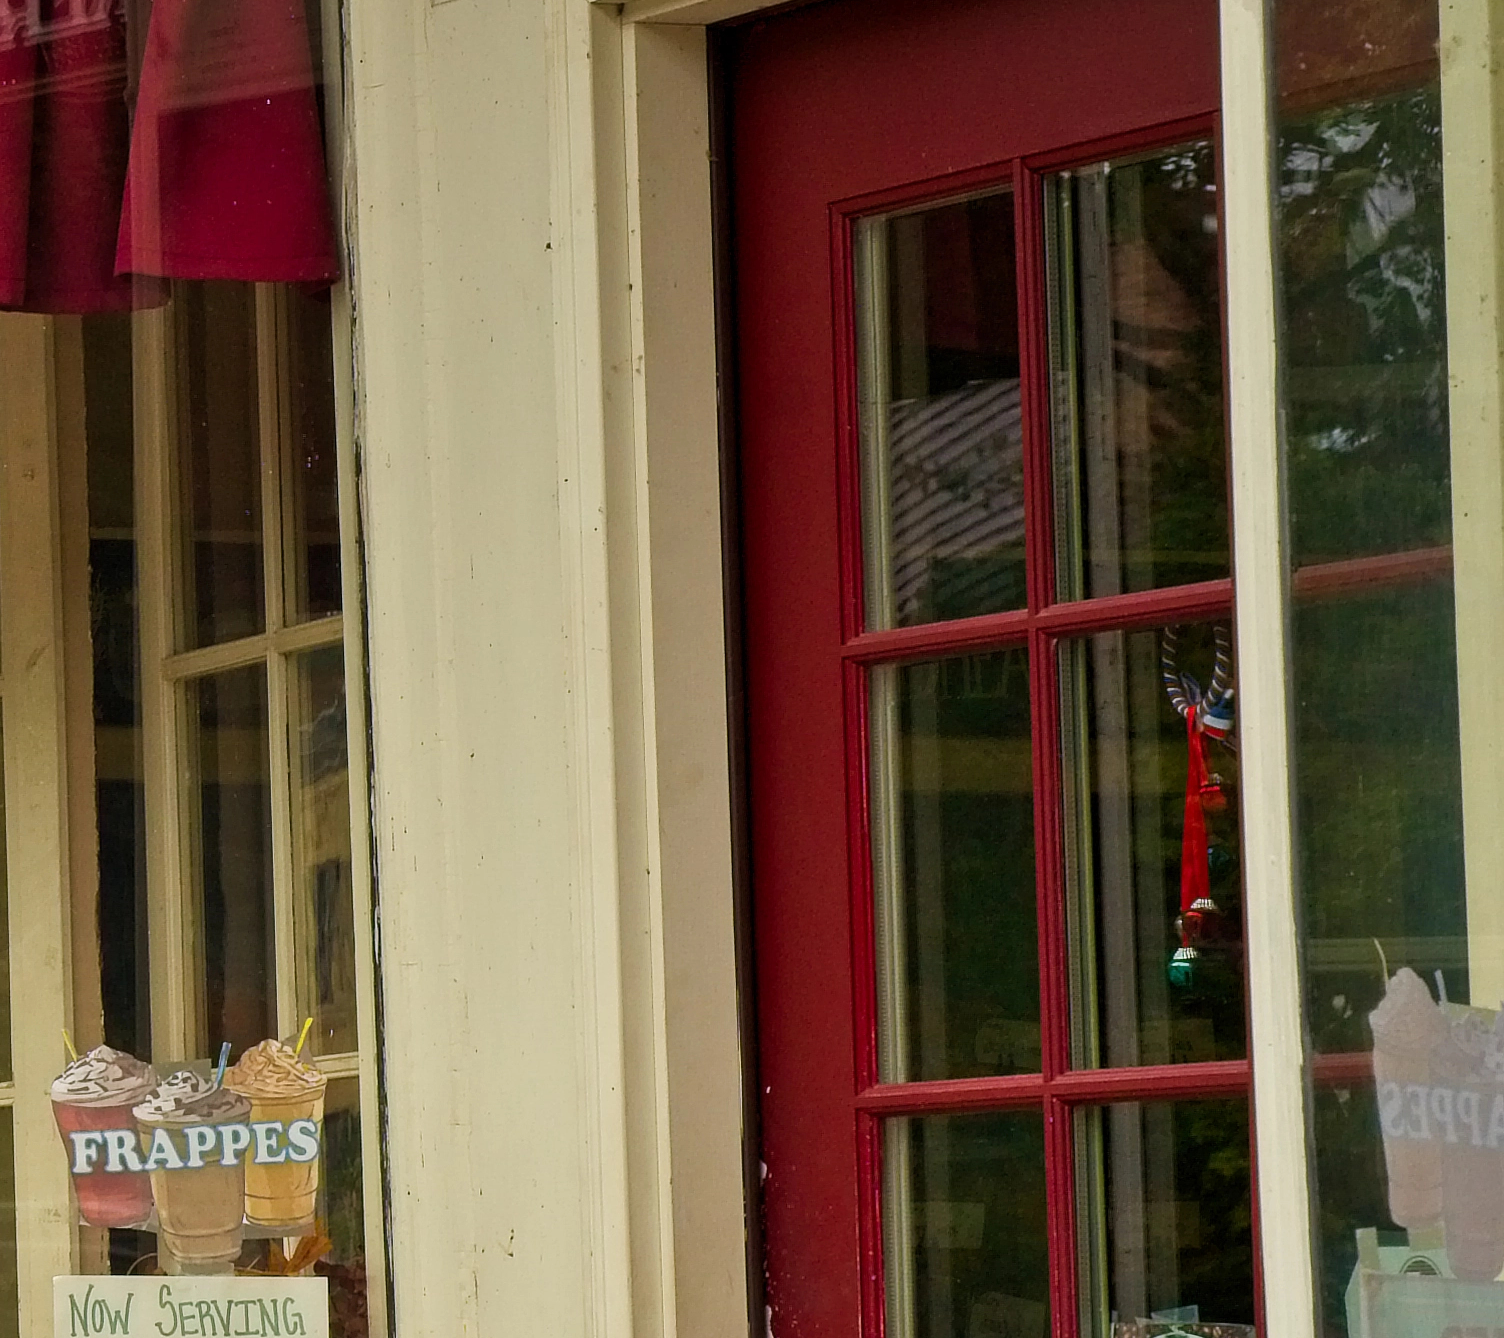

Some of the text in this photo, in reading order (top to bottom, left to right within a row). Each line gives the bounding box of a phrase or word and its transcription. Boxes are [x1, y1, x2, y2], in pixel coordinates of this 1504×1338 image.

[70, 1118, 320, 1175] FRAPPES
[68, 1284, 307, 1338] NOW SERVING
